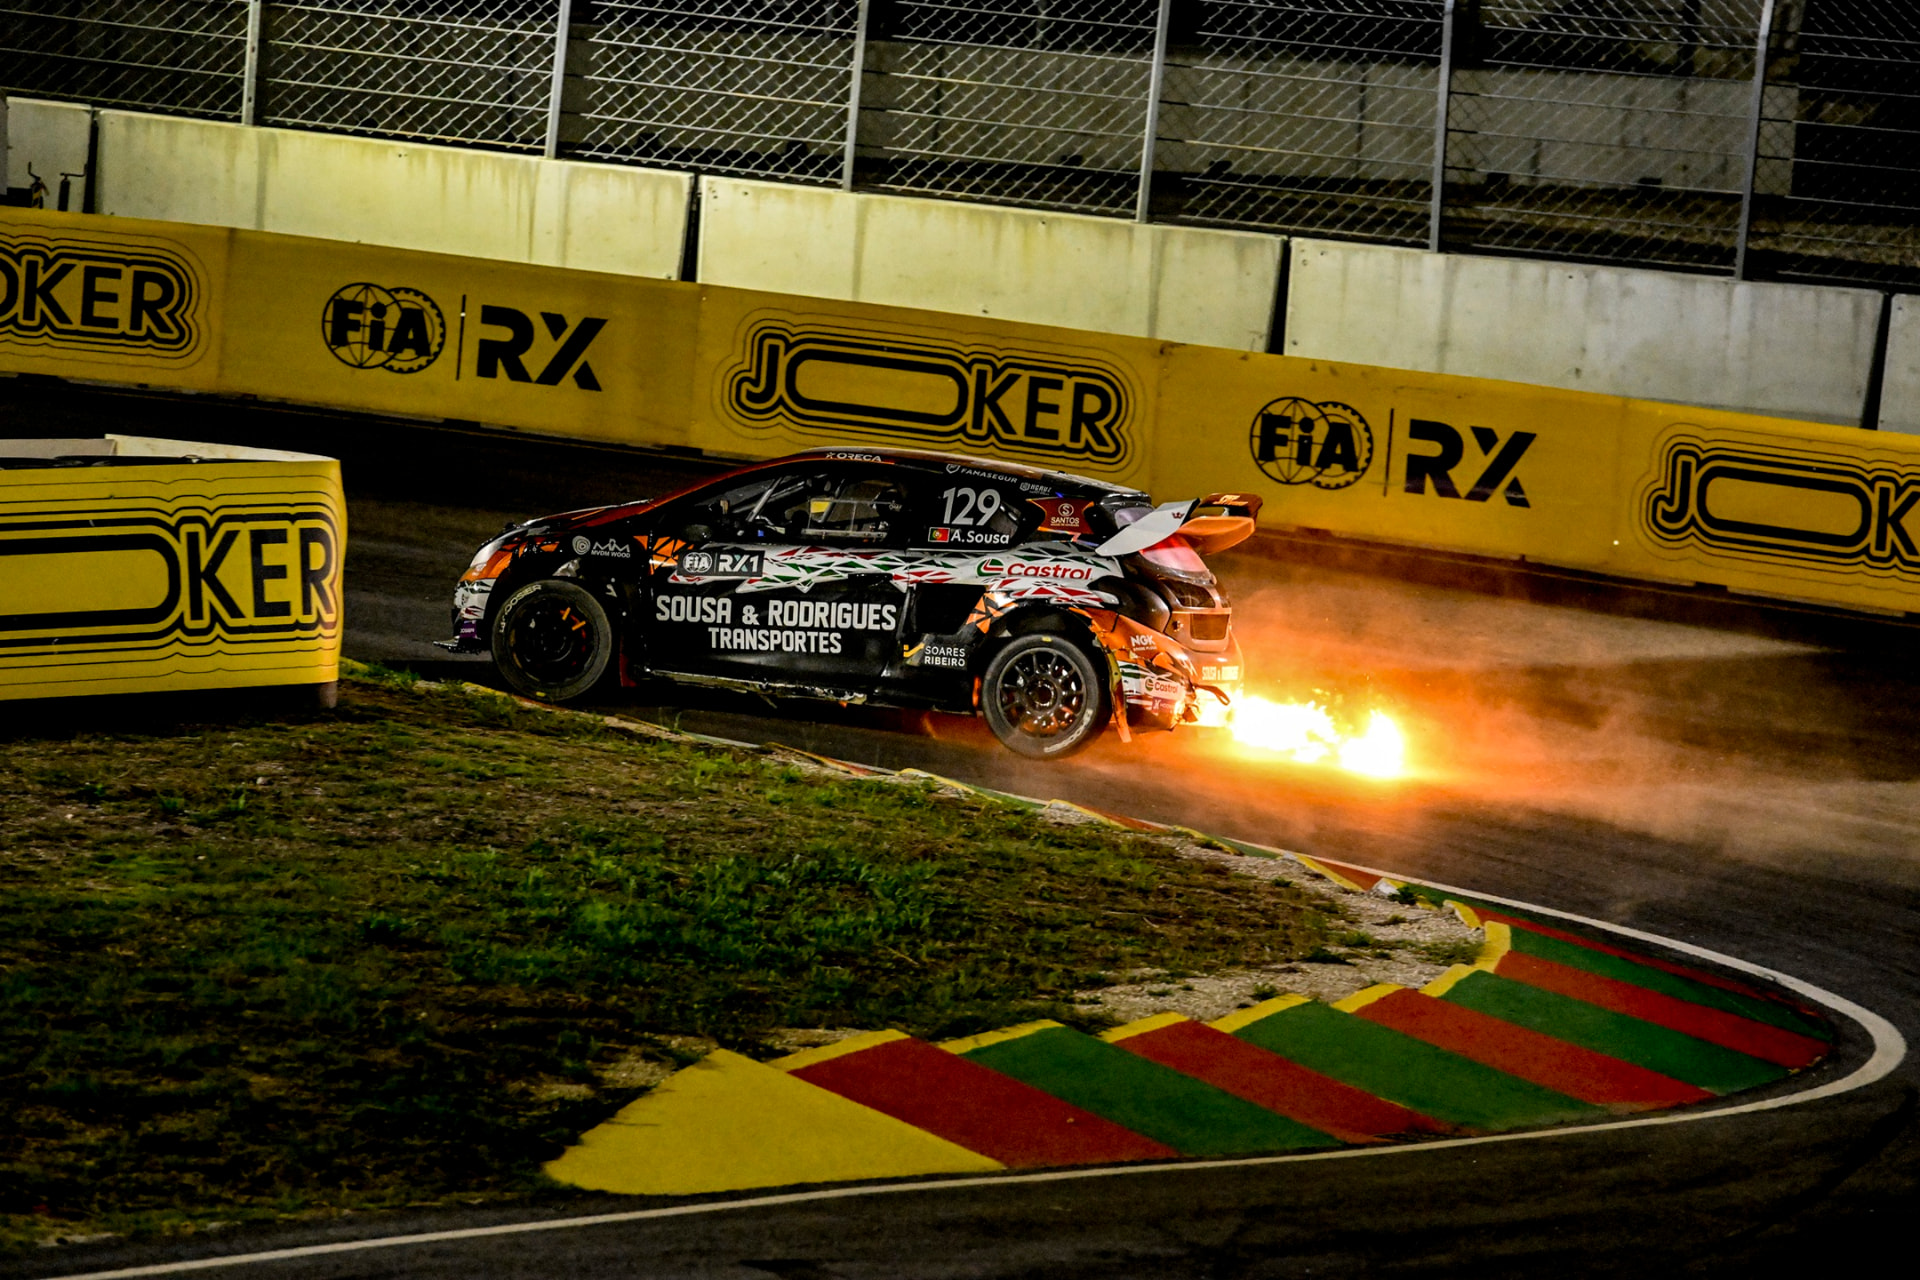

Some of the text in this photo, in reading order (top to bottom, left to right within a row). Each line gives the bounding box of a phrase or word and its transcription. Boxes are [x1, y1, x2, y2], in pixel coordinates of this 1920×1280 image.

[0, 257, 175, 334] KER
[476, 304, 609, 392] RX
[744, 343, 1118, 453] JOKER
[837, 453, 882, 462] ORECA
[1404, 418, 1538, 509] RX
[943, 487, 1001, 526] 129
[1051, 516, 1080, 524] SANTOS
[611, 551, 631, 559] WOOD
[718, 554, 759, 573] RX1
[1007, 562, 1093, 580] Castrol
[656, 594, 897, 631] SOUSA & RODRIGUES
[708, 627, 842, 654] TRANSPORTES
[1130, 634, 1156, 647] NGK
[924, 645, 966, 658] SOARES
[924, 655, 966, 667] RIBEIRO
[1154, 681, 1178, 694] Castrol
